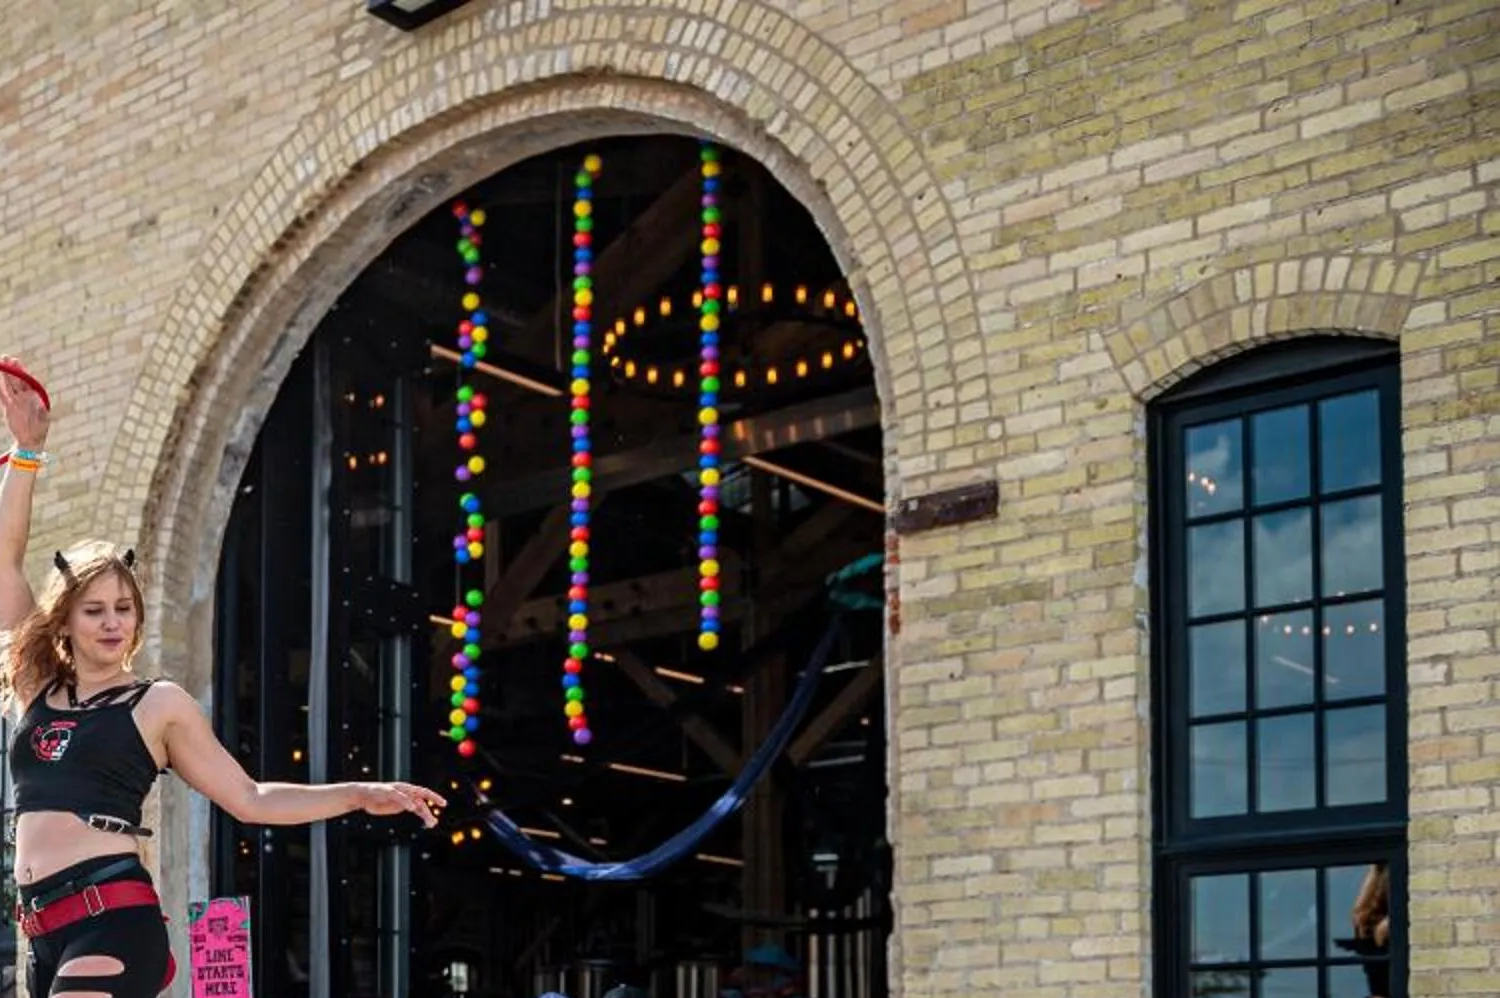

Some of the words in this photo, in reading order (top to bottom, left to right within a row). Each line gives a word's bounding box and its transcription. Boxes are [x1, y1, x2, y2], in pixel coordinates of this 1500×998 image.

[205, 948, 235, 963] LINE
[197, 965, 245, 981] STARTS
[205, 981, 238, 997] HERE
